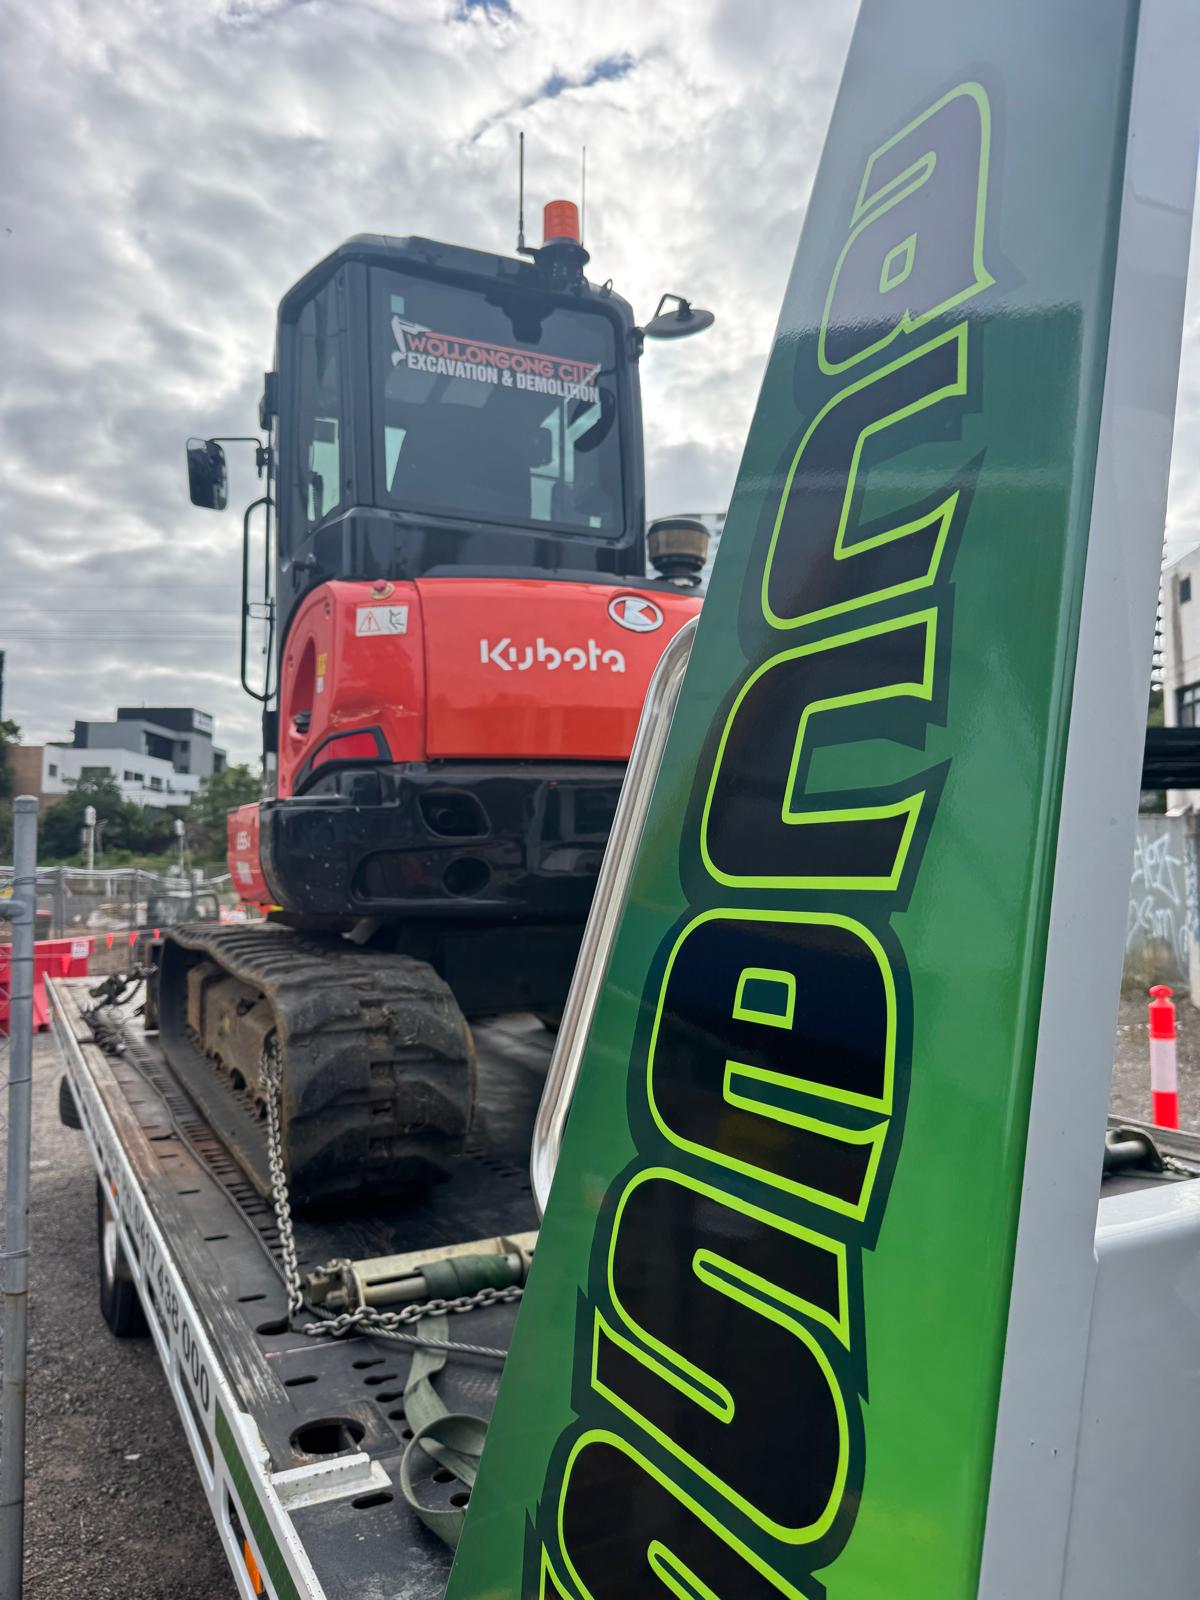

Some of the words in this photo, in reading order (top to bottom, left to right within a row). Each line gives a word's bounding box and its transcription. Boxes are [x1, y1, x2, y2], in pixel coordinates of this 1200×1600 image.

[407, 334, 554, 378] WOLLONGONG
[558, 363, 600, 385] CITY
[407, 351, 499, 385] EXCAVATION
[501, 369, 514, 387] &
[516, 372, 601, 404] DEMOLITION
[480, 638, 626, 673] Kubota
[182, 1318, 210, 1413] 000
